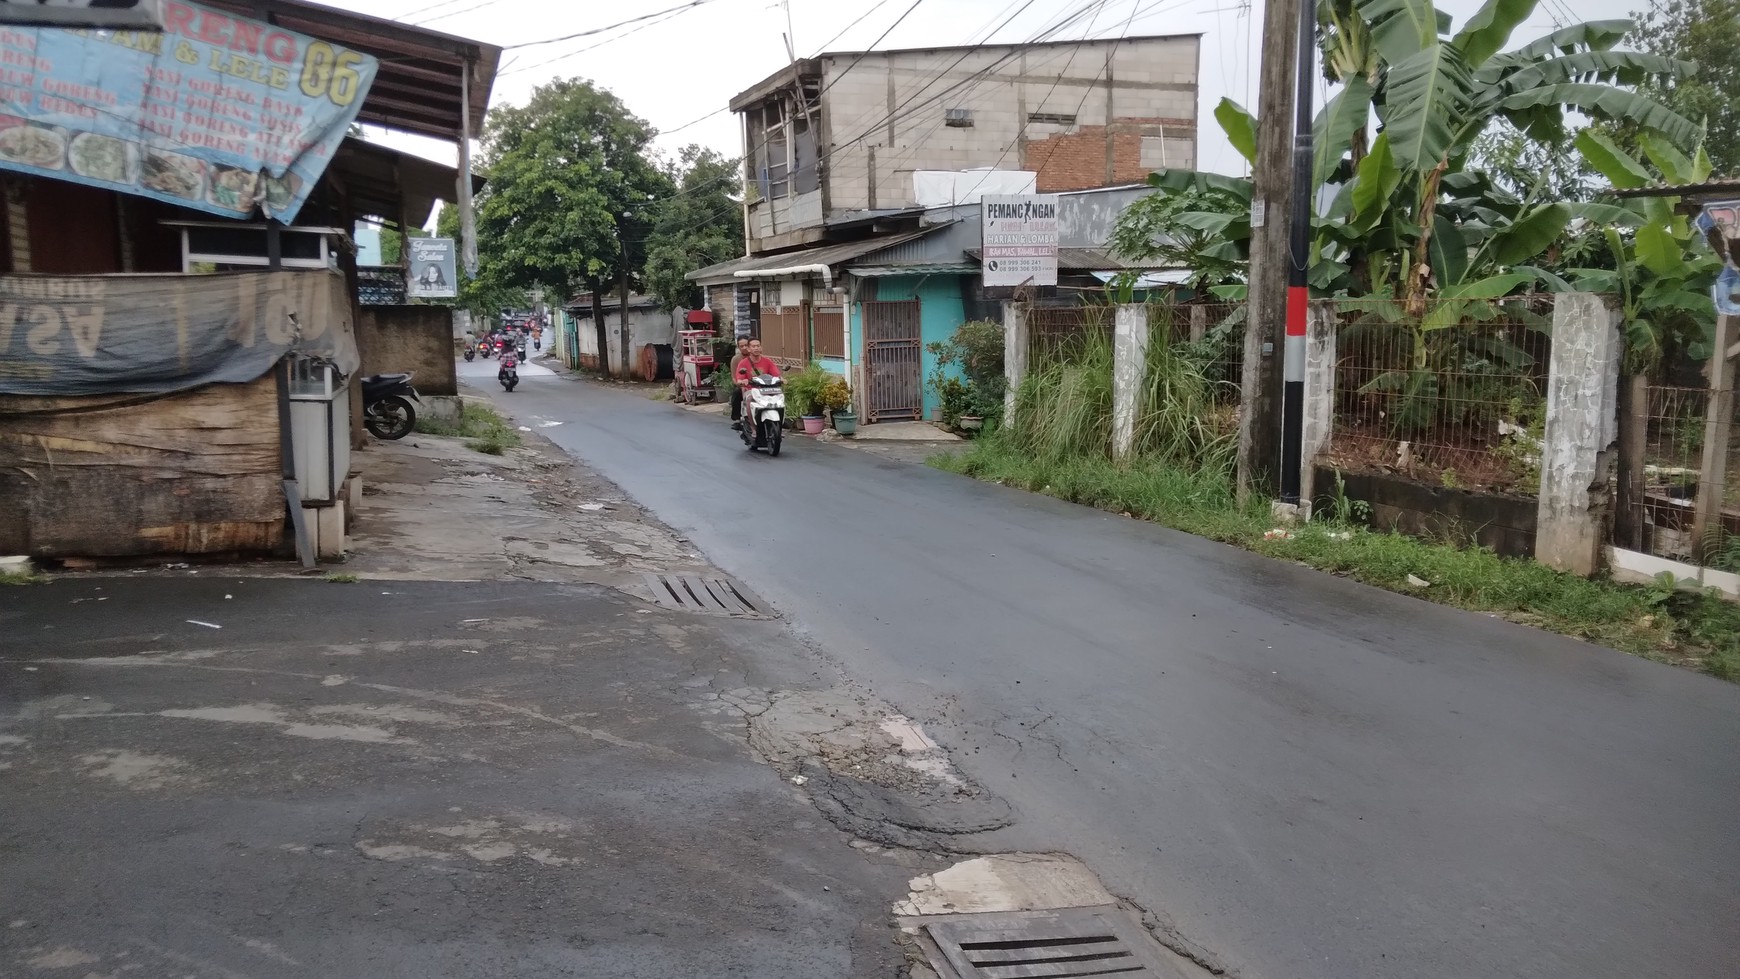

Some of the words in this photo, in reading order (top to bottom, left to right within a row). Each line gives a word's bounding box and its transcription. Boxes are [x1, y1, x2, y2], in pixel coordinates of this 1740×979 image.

[144, 64, 183, 86] NASI
[188, 78, 256, 105] GORENG
[175, 40, 199, 65] &
[208, 49, 289, 90] LELE
[299, 40, 362, 107] 86
[140, 100, 176, 120] NASI
[183, 111, 249, 139] GORENG
[142, 82, 180, 103] NASI
[185, 93, 252, 121] GORENG
[179, 128, 246, 156] GORENG
[987, 234, 1018, 244] HARIAN
[1020, 234, 1026, 244] &
[1028, 234, 1054, 244] LOMBA
